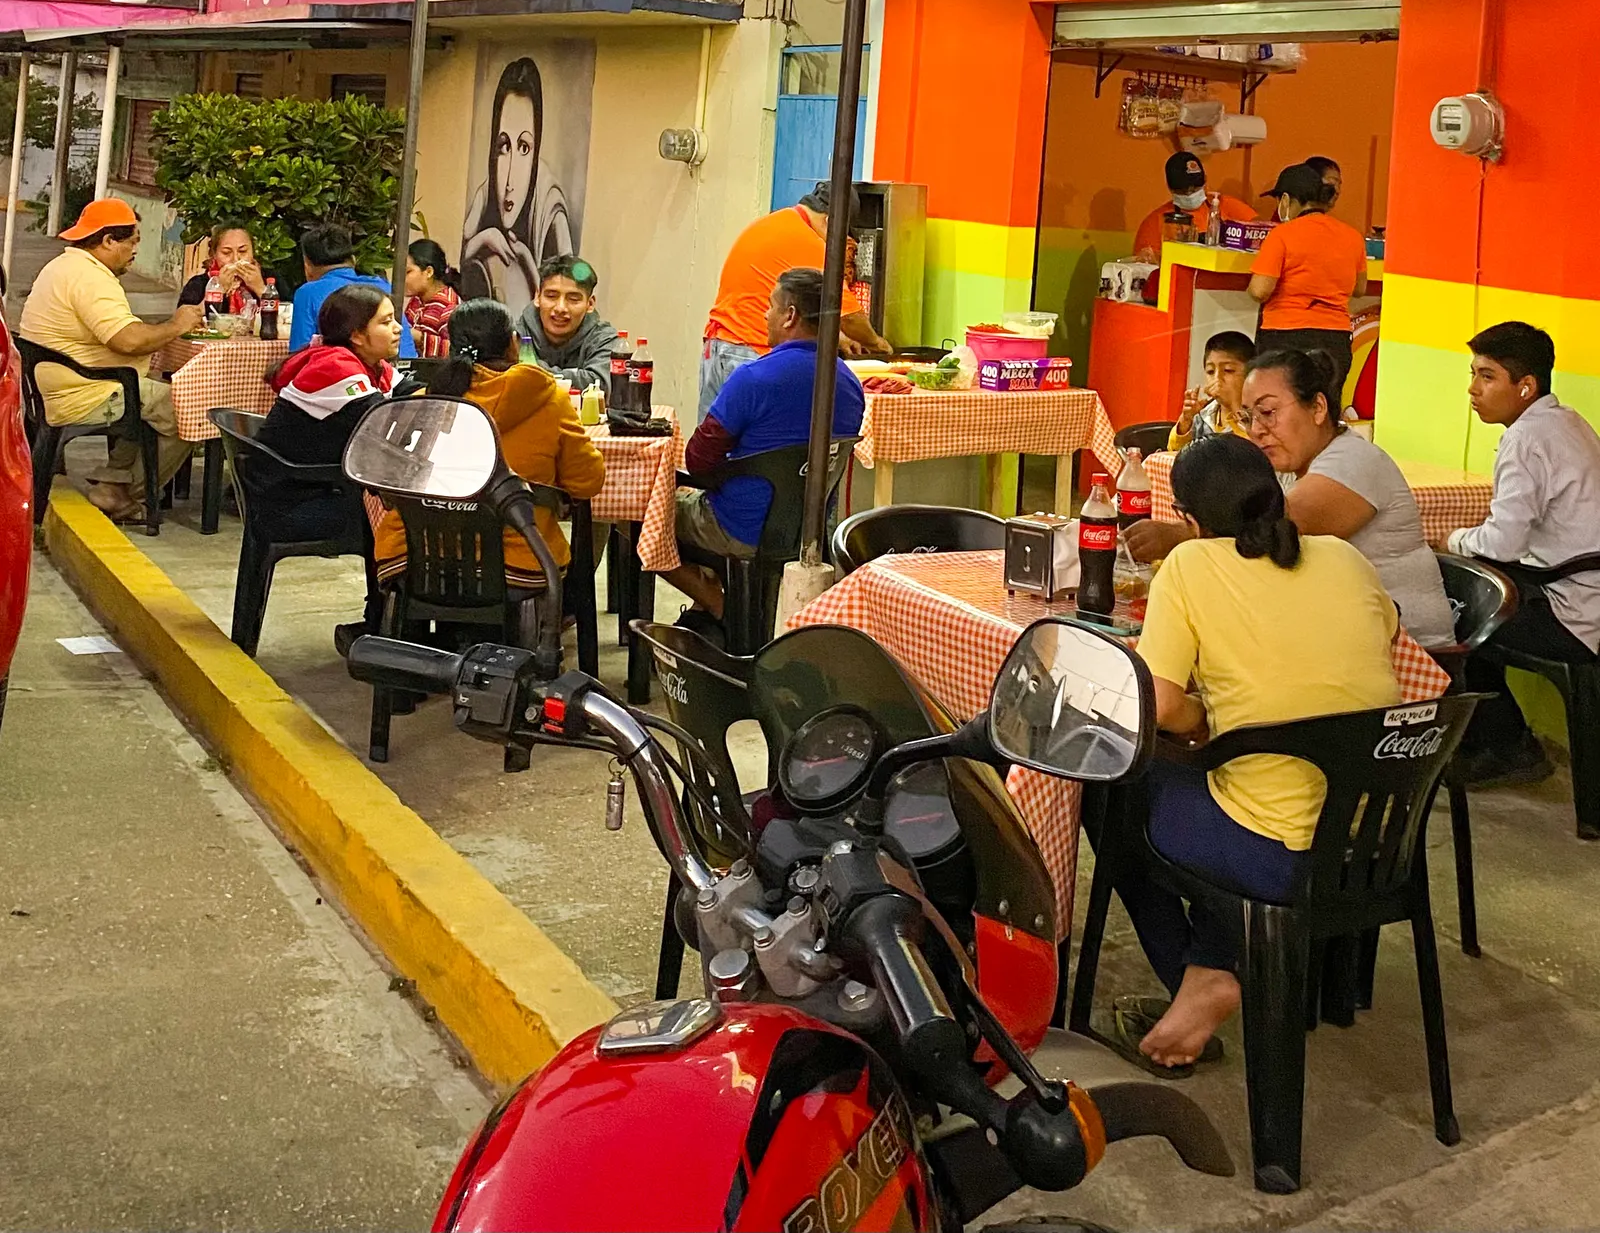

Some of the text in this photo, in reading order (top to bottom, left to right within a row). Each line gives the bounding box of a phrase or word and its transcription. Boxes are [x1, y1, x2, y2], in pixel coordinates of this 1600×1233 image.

[1226, 226, 1242, 238] 400
[982, 365, 1067, 383] 400 MEGA 400
[1008, 379, 1038, 390] MAX
